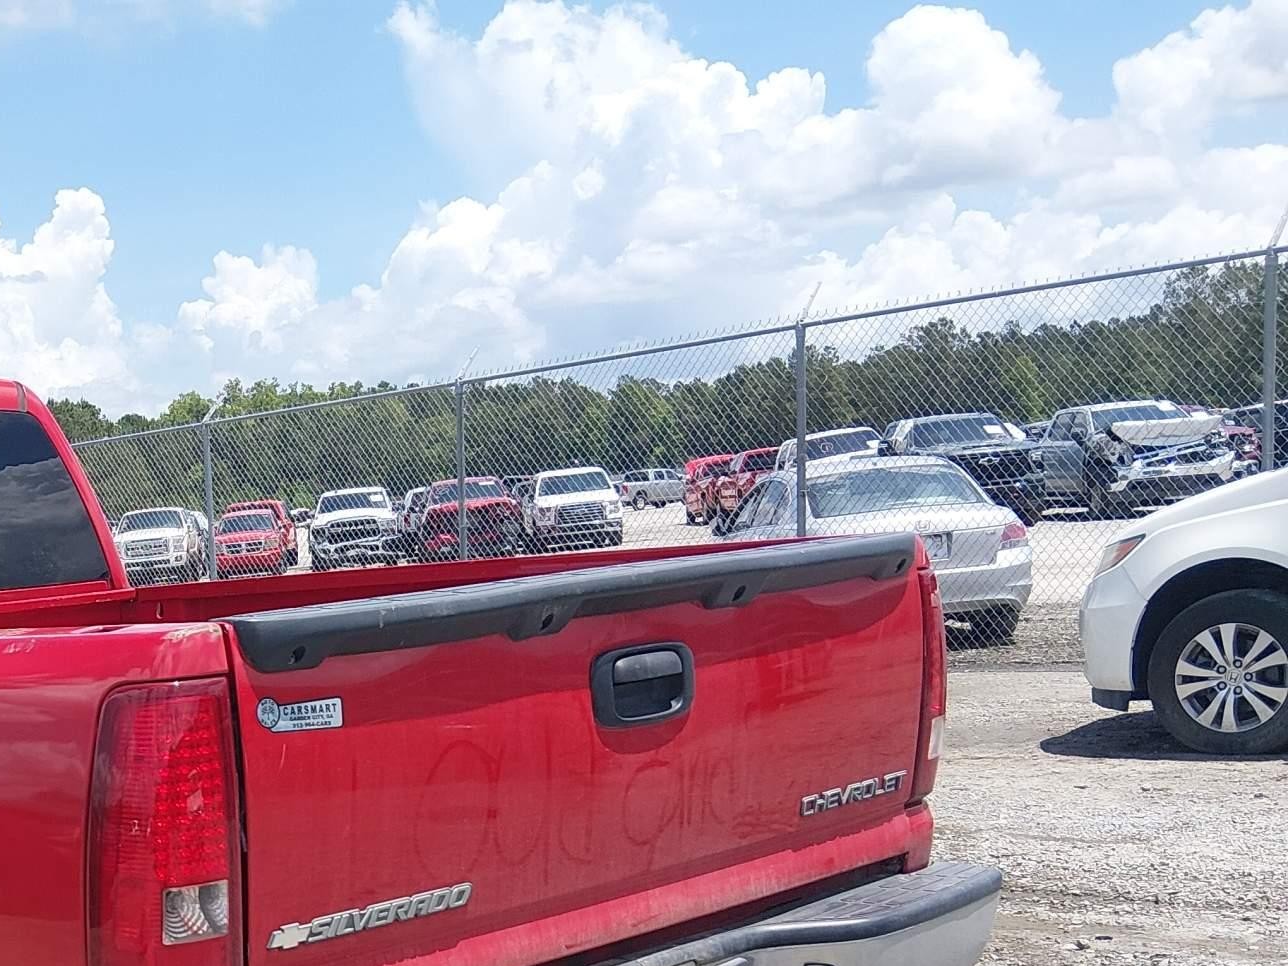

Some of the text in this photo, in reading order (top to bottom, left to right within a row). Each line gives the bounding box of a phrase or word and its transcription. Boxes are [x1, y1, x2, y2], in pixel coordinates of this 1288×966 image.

[282, 703, 337, 717] CARSMART
[800, 769, 908, 817] CHEVROLET
[307, 882, 473, 944] SILVERADO
